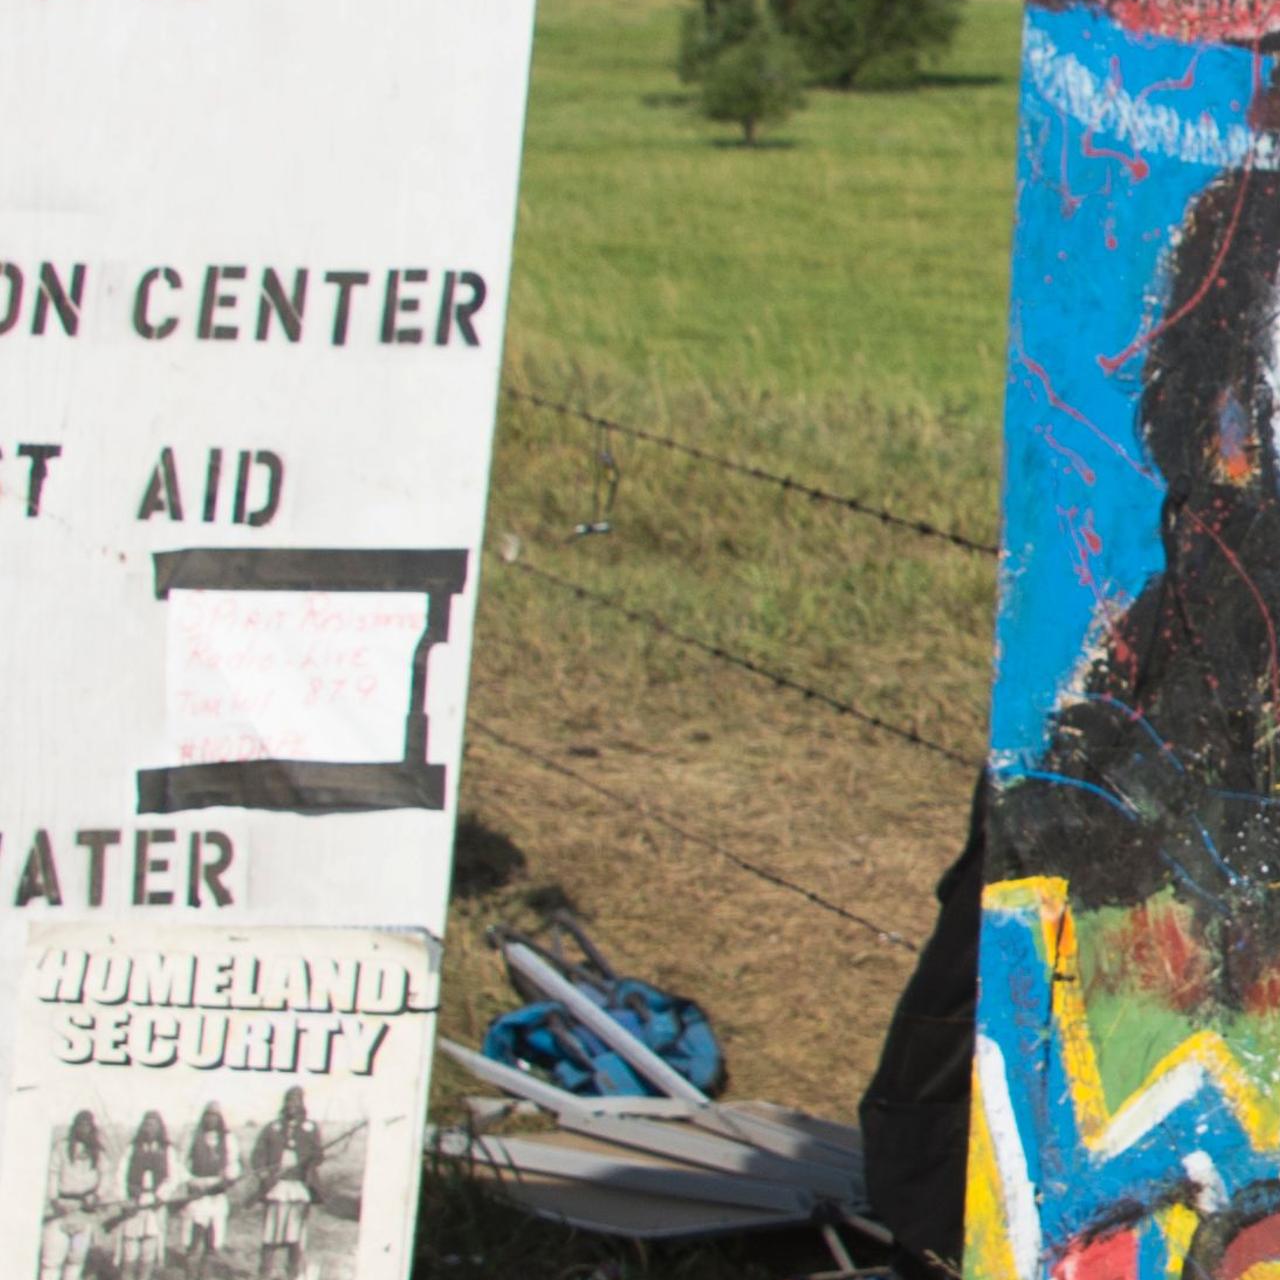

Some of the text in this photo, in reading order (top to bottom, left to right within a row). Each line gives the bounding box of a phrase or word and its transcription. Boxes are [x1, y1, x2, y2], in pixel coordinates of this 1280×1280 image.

[131, 267, 487, 347] CENTER
[137, 447, 284, 527] AID
[0, 829, 234, 908] ATER
[37, 949, 412, 1015] HOMELAND
[53, 1010, 390, 1076] SECURITY
